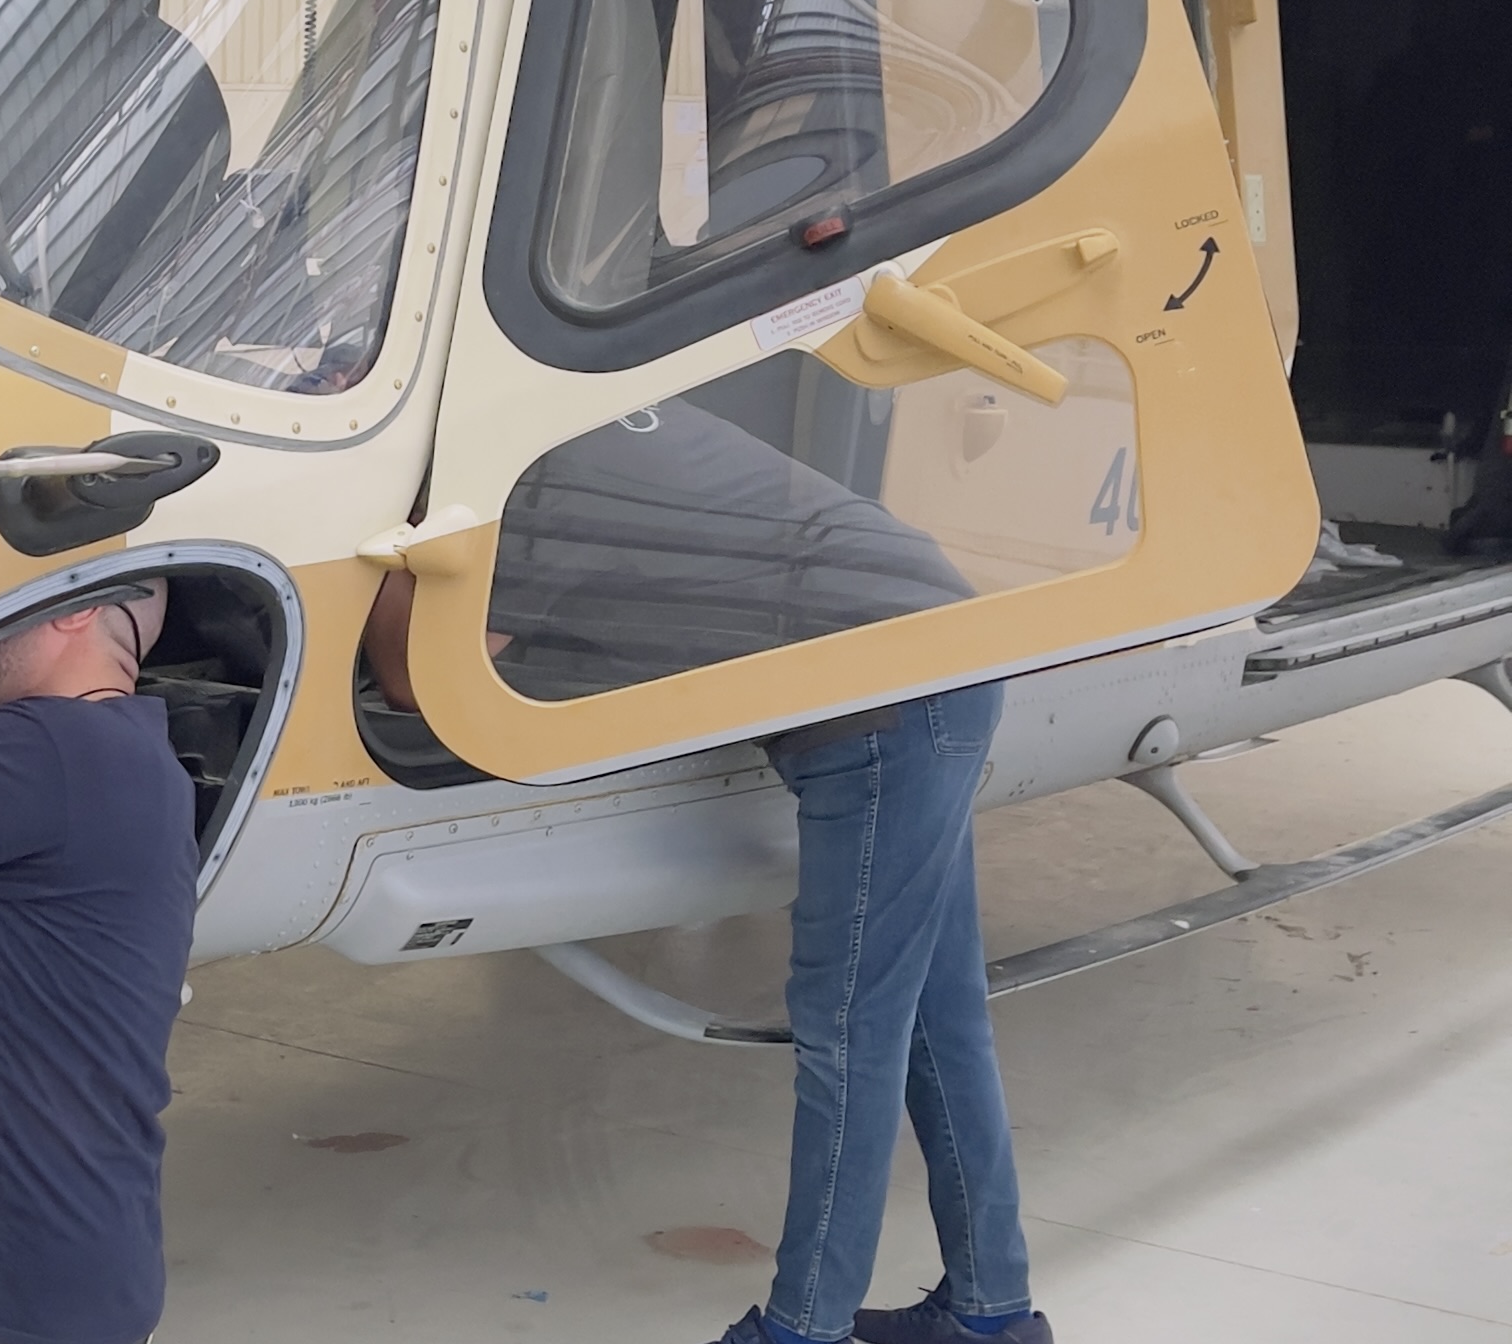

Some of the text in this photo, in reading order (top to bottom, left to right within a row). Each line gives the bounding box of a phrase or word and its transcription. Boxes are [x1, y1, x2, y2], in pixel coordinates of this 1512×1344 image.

[1174, 209, 1219, 230] LOCKED
[770, 288, 842, 324] EMERGENCY EXIT
[1136, 328, 1166, 344] OPEN
